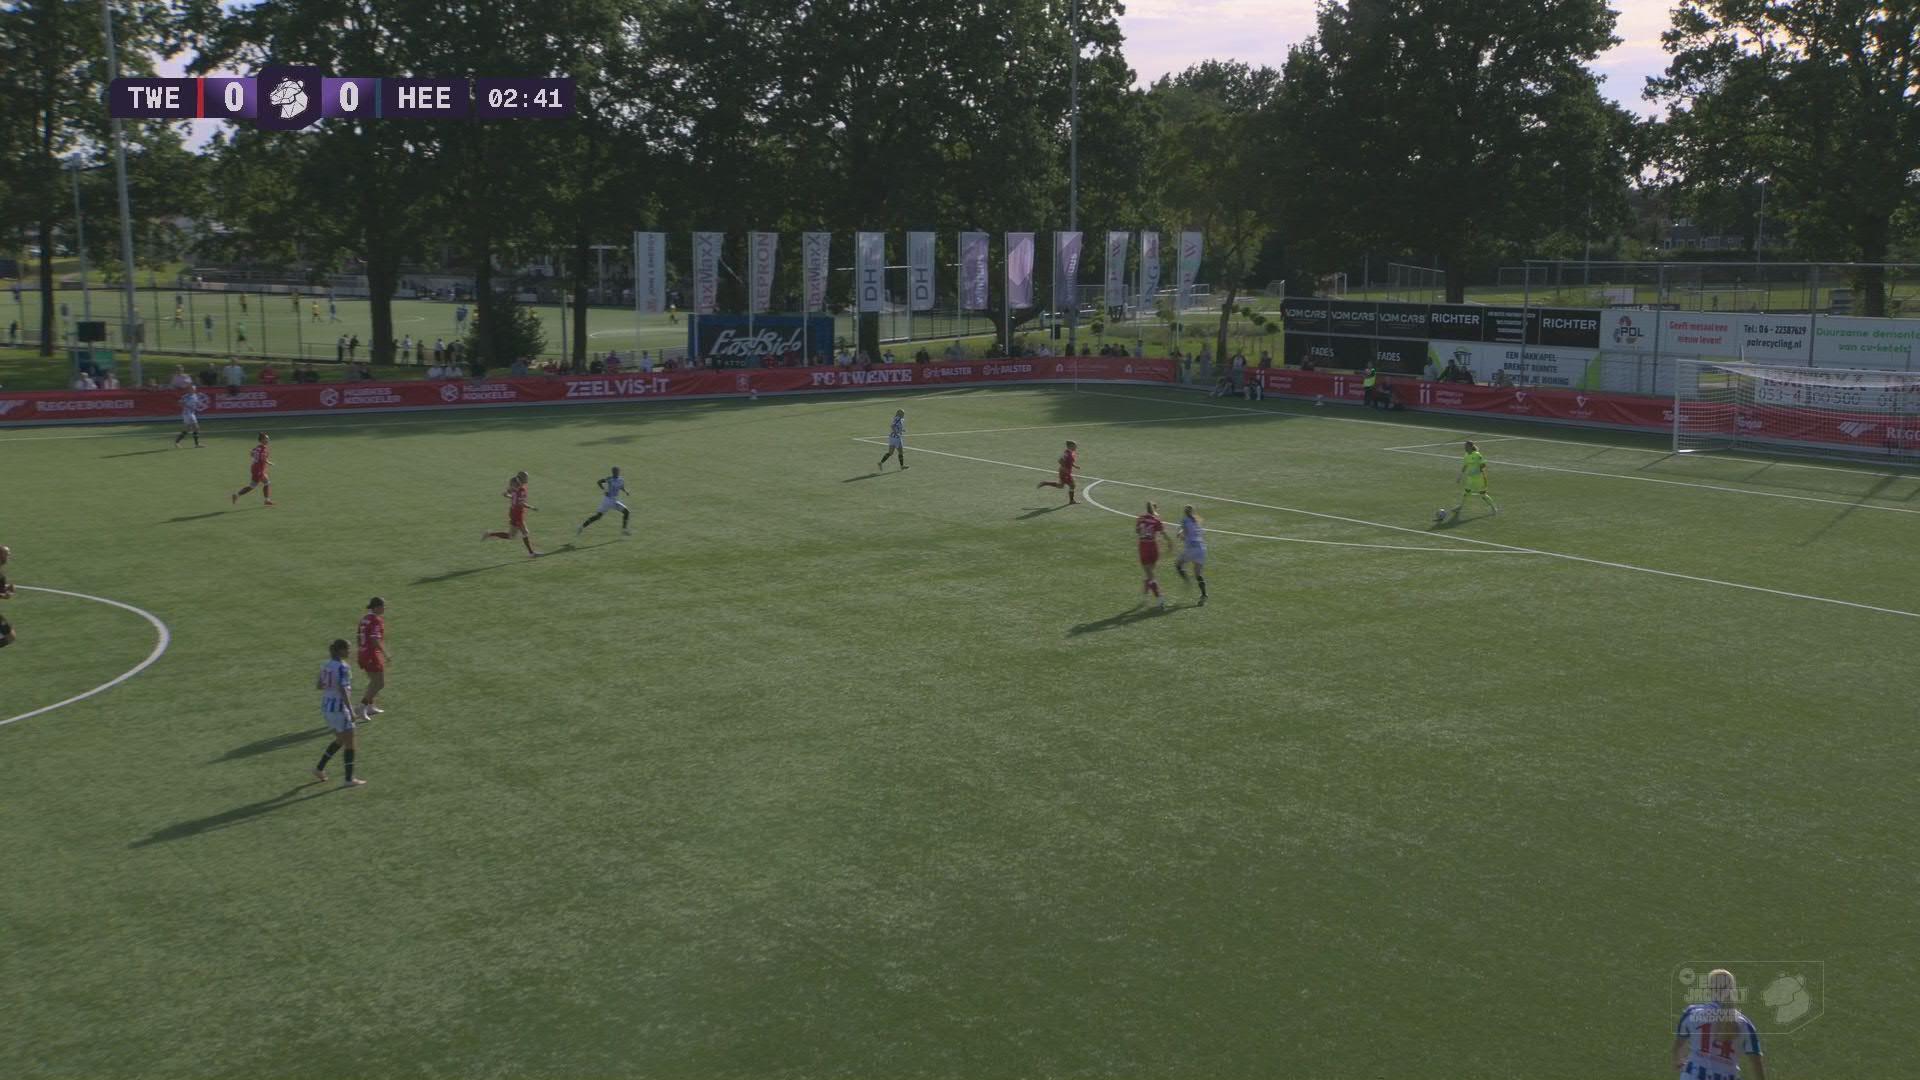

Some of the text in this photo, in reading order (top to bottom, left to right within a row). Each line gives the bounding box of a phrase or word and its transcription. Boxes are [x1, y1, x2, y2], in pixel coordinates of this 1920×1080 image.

[1305, 310, 1327, 319] CARS
[1352, 312, 1375, 321] CARS
[1400, 314, 1425, 324] CARS
[1431, 312, 1480, 325] RICHTER
[1543, 318, 1597, 330] RICHTER
[1620, 327, 1644, 337] POL
[1816, 328, 1868, 338] Duurzame
[1377, 351, 1400, 362] FADES
[811, 369, 913, 385] FC TWENTE
